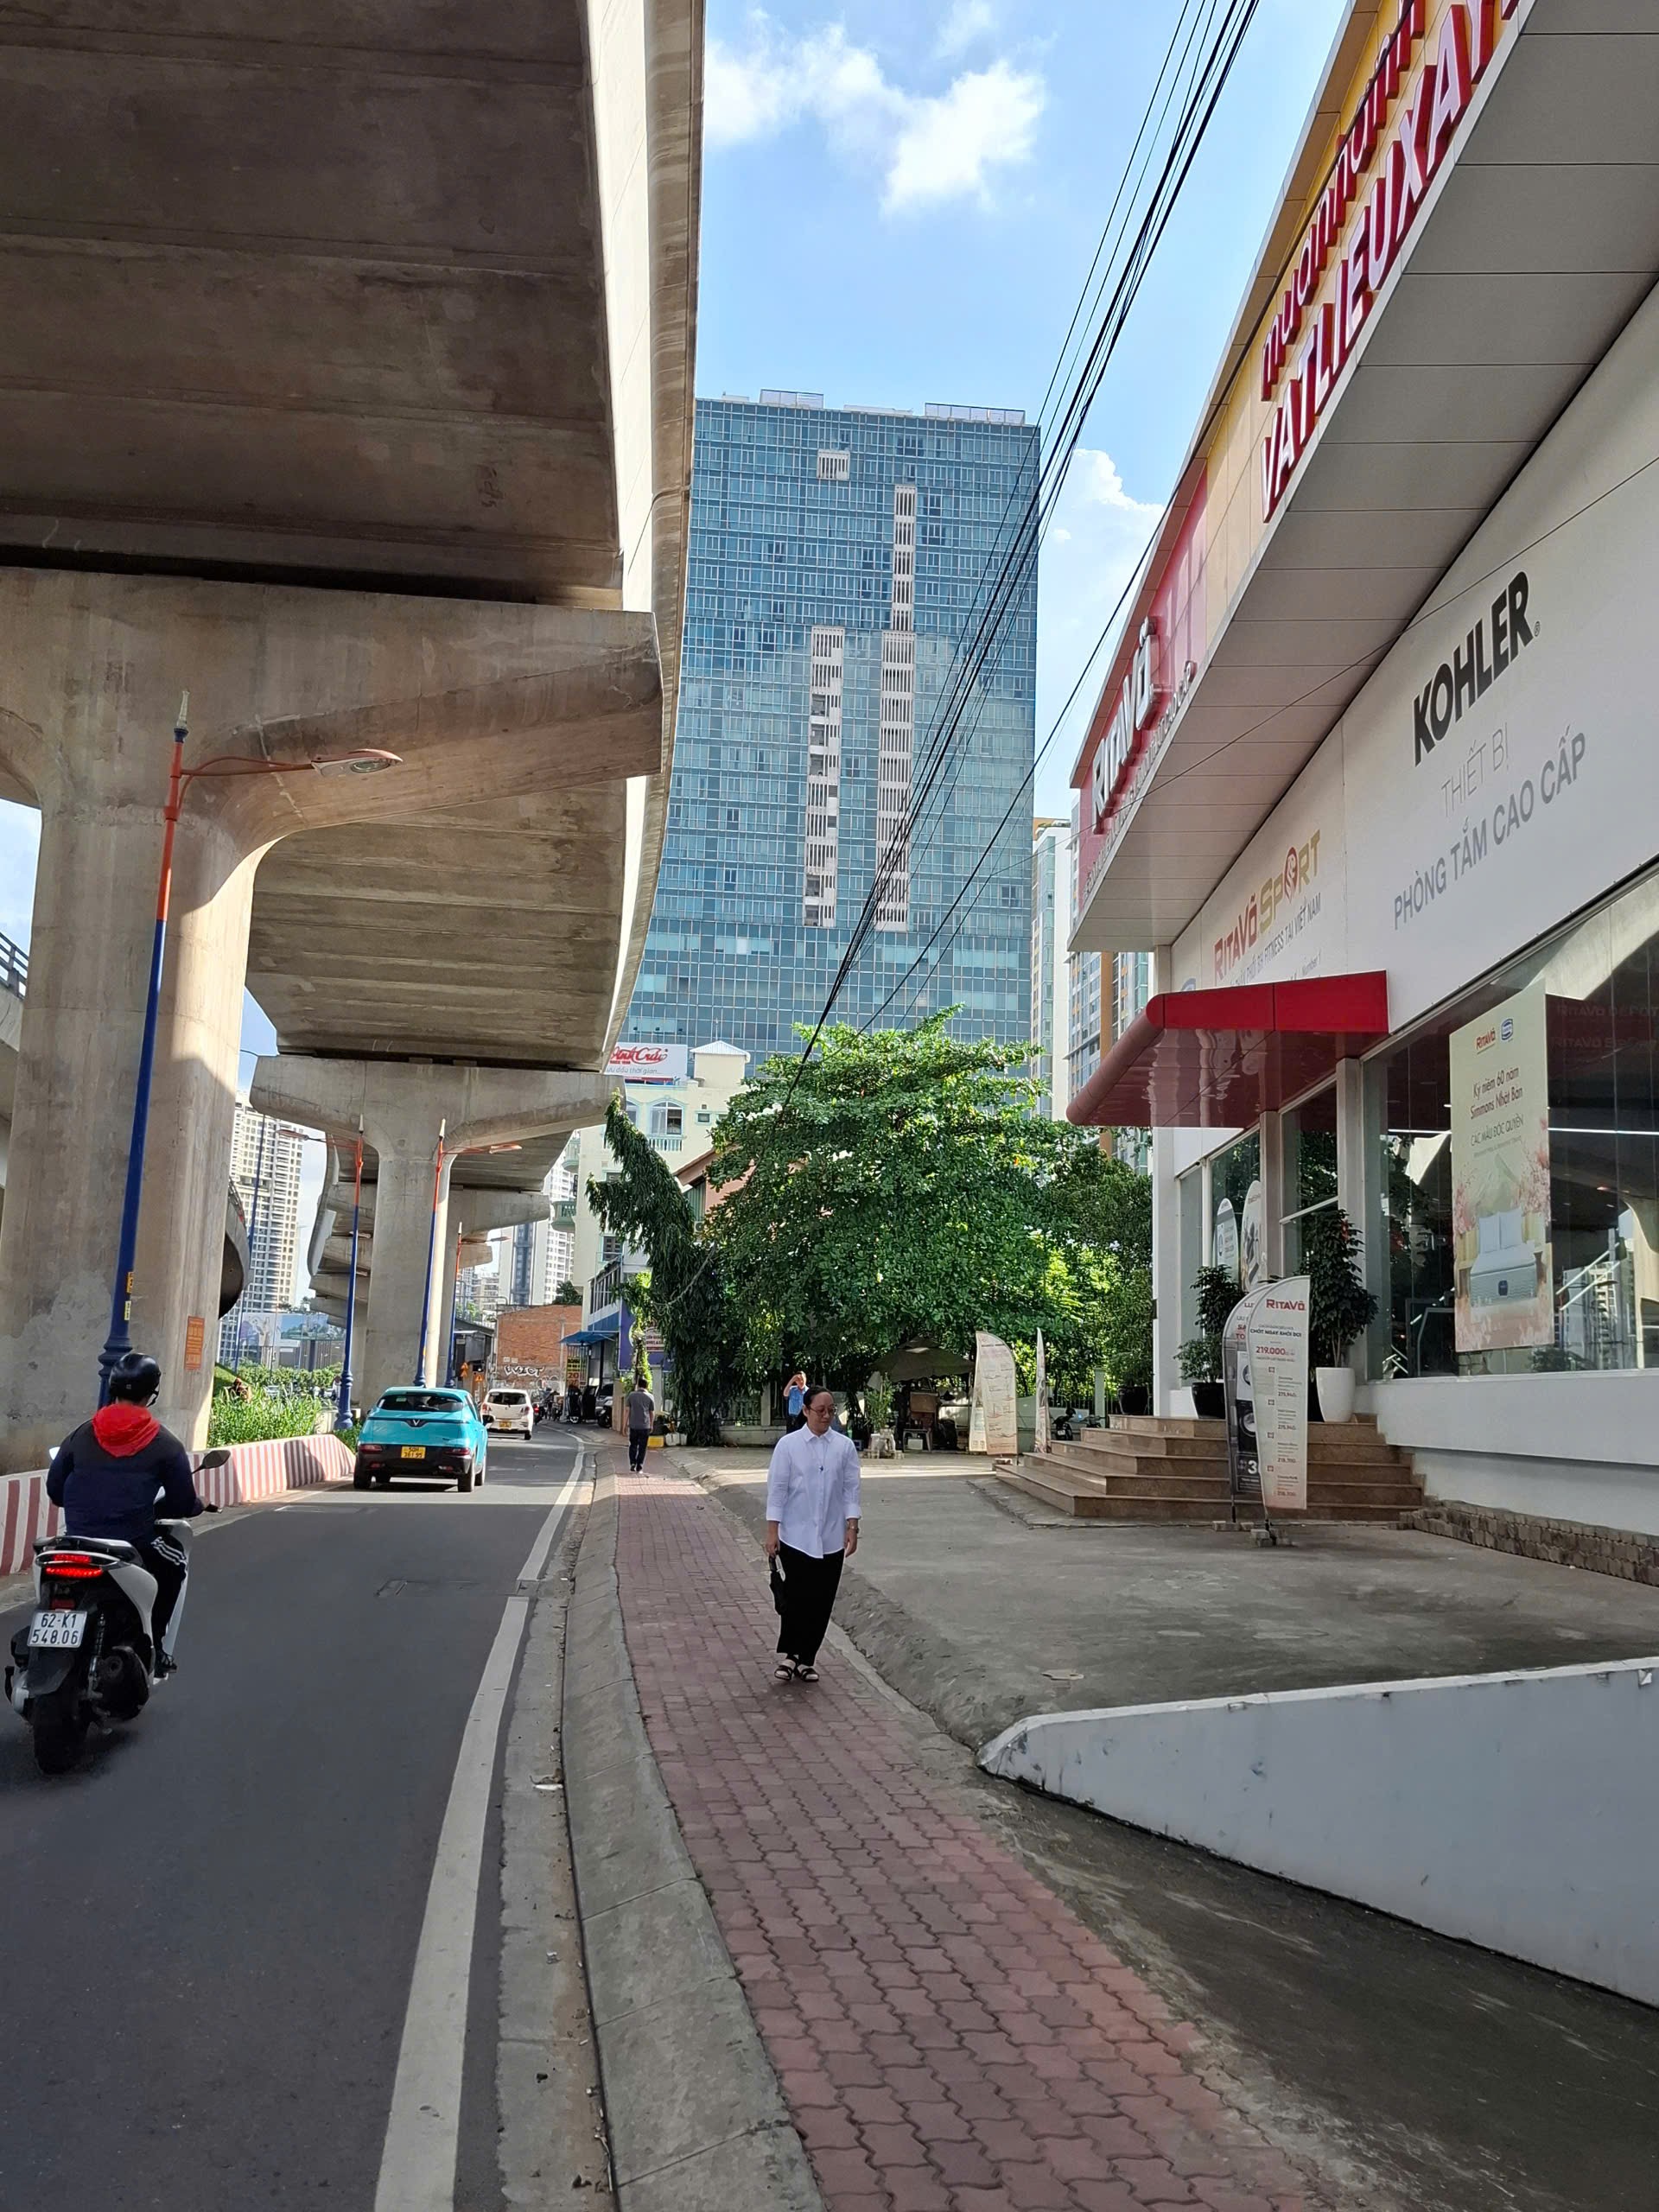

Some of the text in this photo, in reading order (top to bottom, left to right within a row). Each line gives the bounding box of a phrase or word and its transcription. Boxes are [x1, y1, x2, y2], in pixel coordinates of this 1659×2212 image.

[1414, 571, 1534, 767] KOHLER
[1440, 721, 1510, 817] THIẾT BỊ
[1394, 723, 1586, 931] PHÒNG TẮM CAO CẤP
[1306, 892, 1321, 924] NAM
[1496, 1069, 1504, 1087] 60
[41, 1613, 77, 1628] 62-K1
[32, 1630, 79, 1644] 548.06
